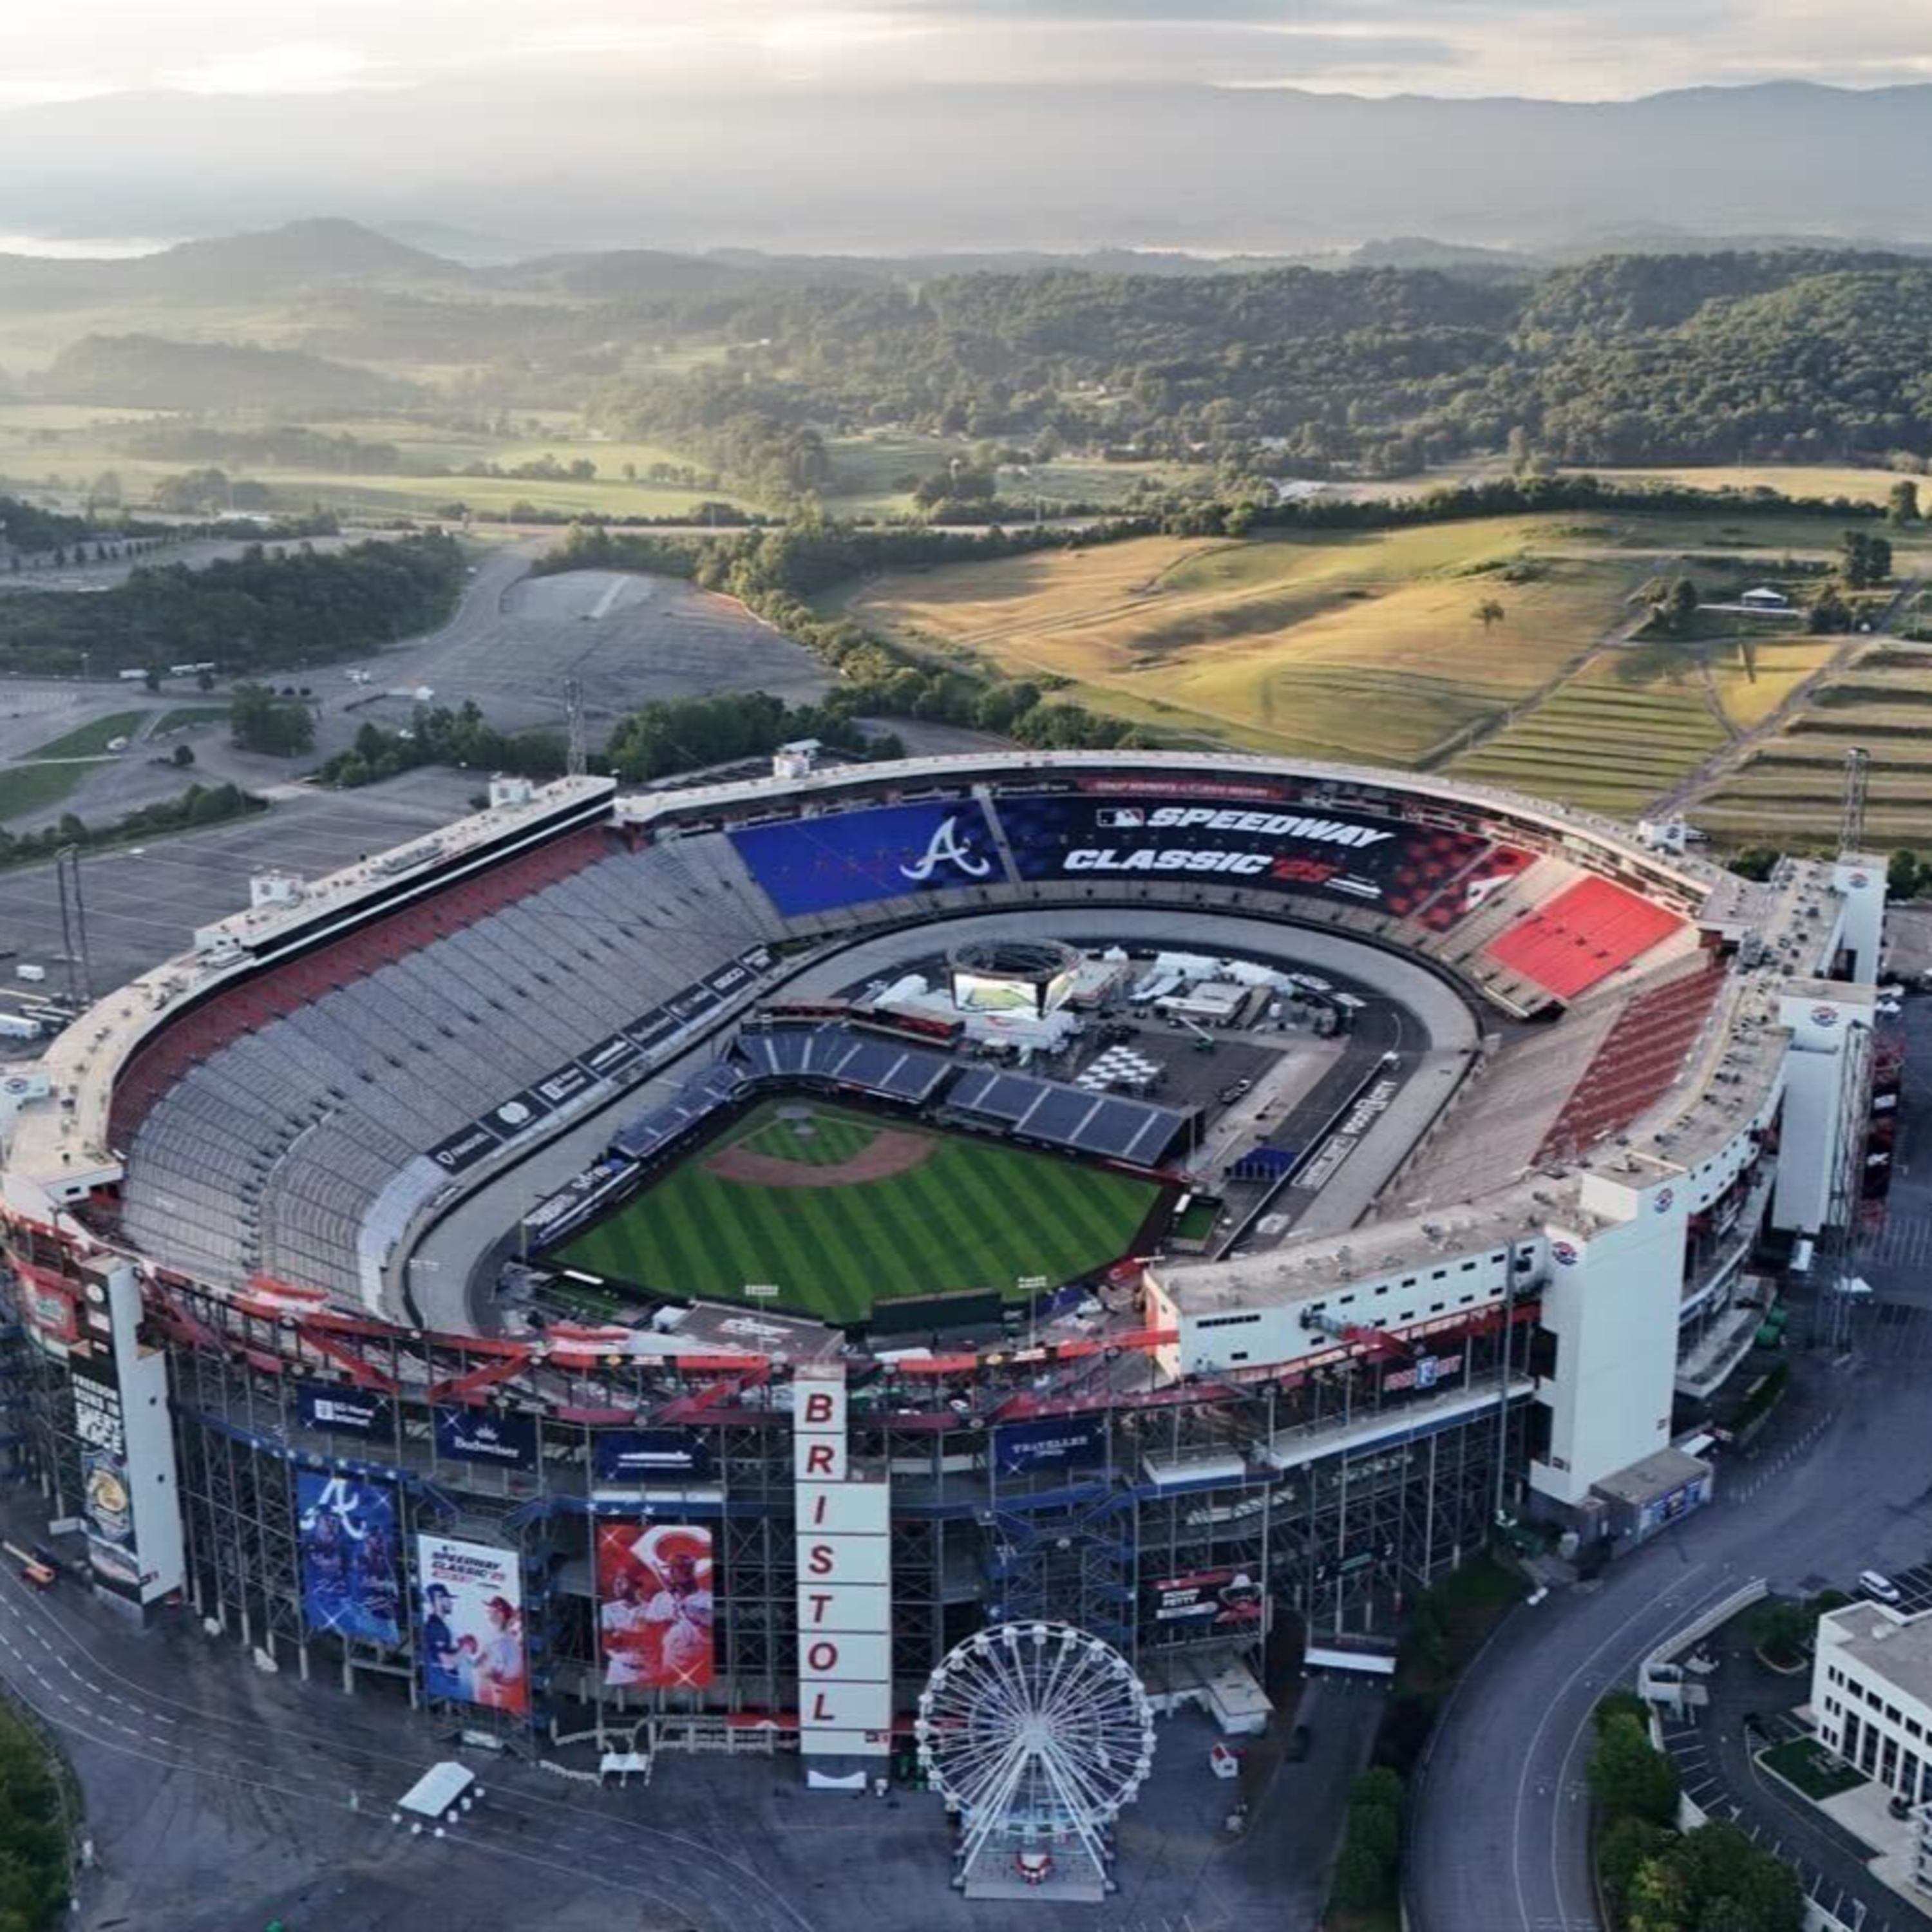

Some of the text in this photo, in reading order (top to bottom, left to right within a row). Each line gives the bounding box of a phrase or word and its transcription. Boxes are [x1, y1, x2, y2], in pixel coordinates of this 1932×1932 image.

[1147, 808, 1396, 848] SPEEDWAY
[900, 815, 990, 880] A
[1063, 849, 1274, 875] CLASSIC
[431, 1560, 488, 1578] CLASSIC
[432, 1551, 502, 1570] SPEEDWAY
[805, 1393, 838, 1721] BRISTOL
